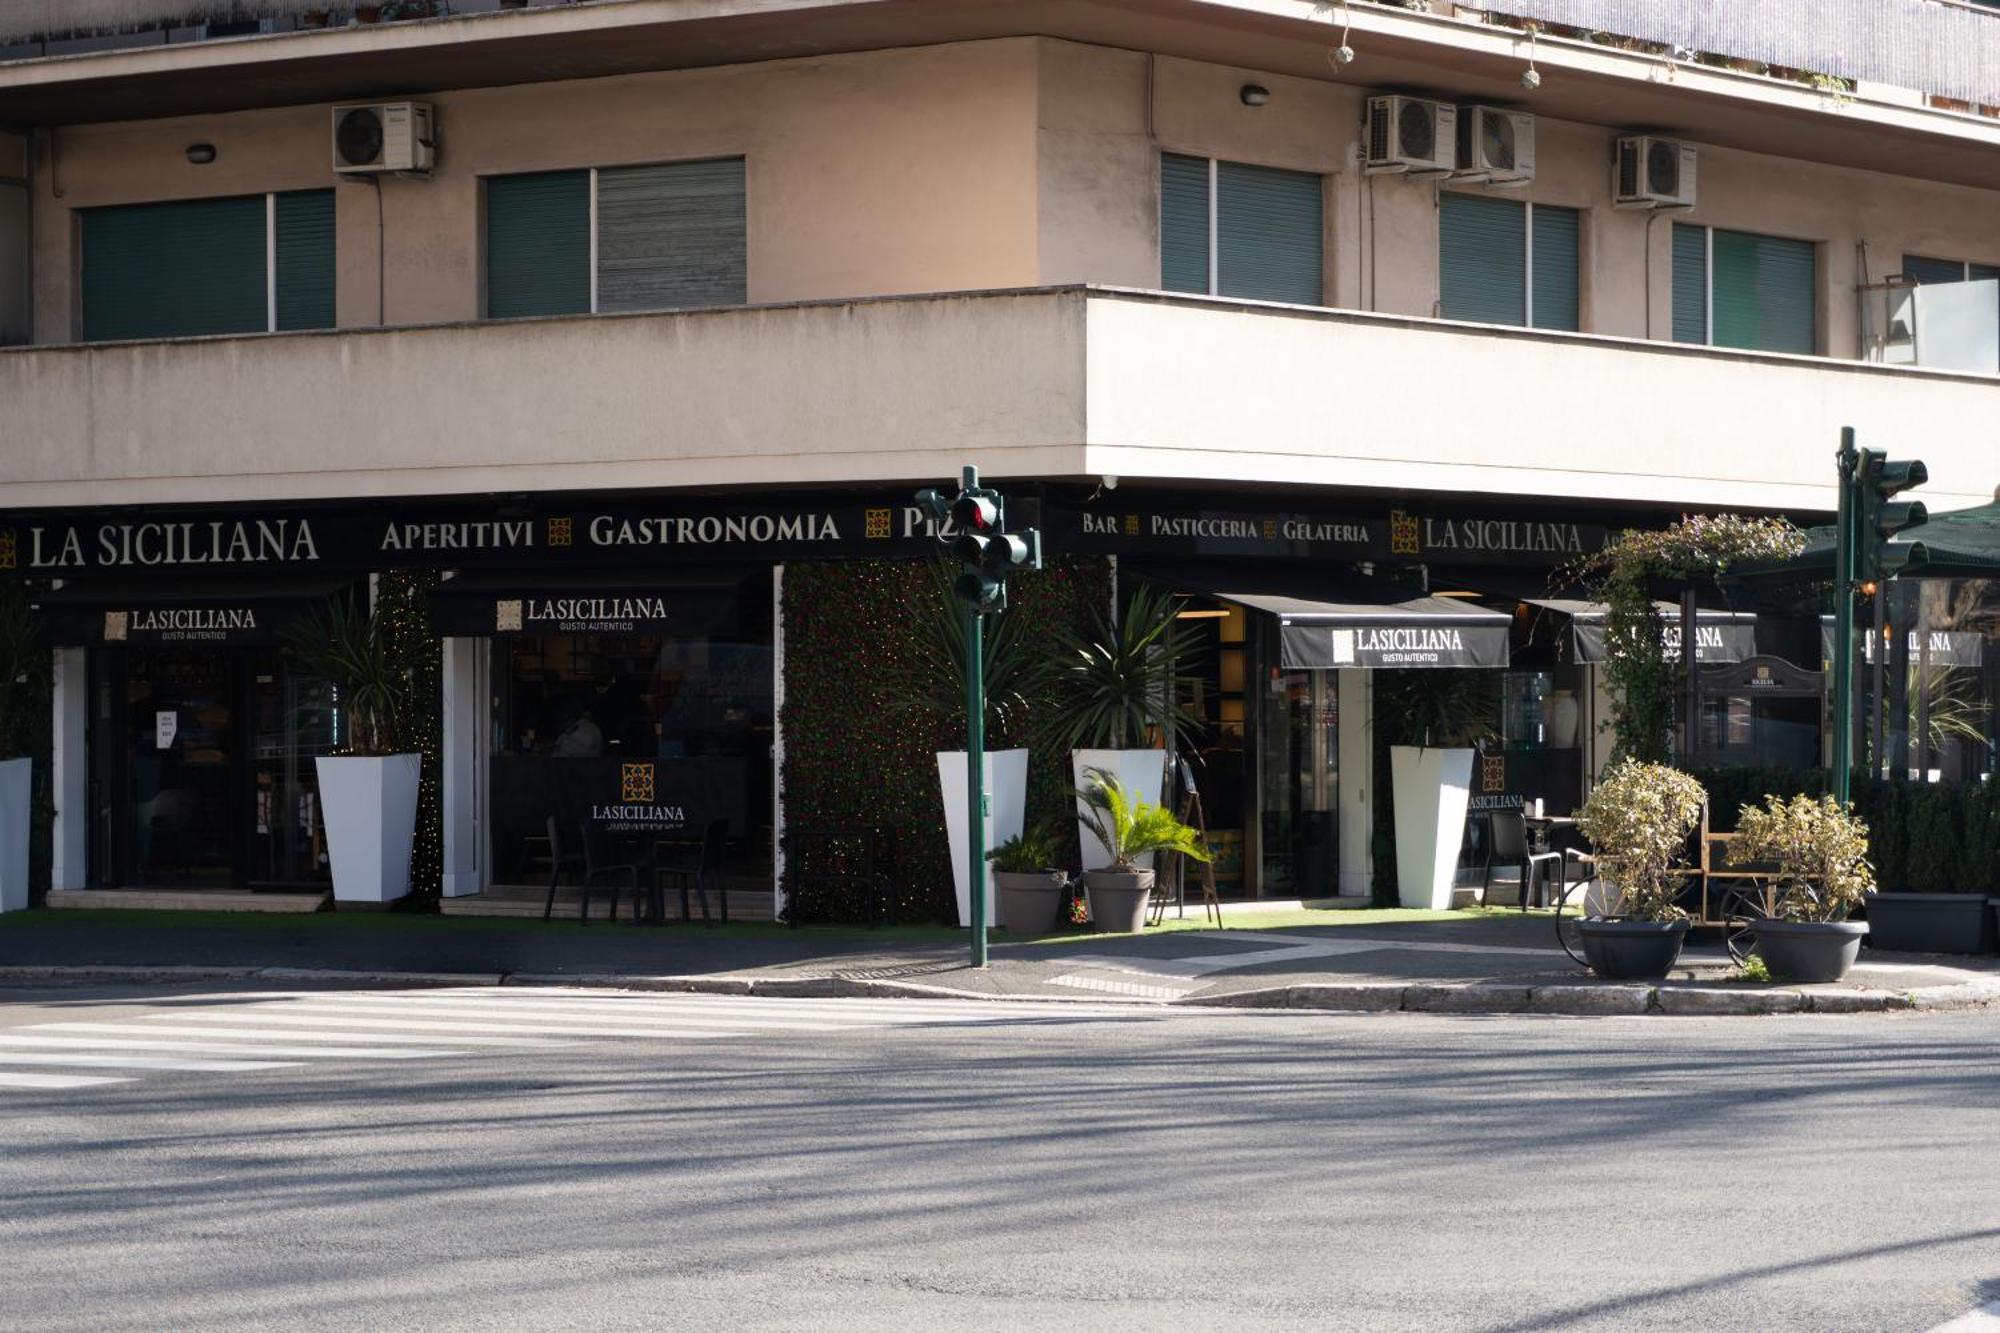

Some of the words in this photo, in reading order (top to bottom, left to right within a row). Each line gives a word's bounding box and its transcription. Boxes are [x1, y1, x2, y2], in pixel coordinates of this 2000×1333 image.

[589, 514, 841, 545] GASTRONOMIA
[1082, 512, 1118, 534] BAR
[1151, 515, 1258, 538] PASTICCERIA
[1282, 521, 1370, 544] GELATERIA
[29, 526, 86, 568] LA
[98, 519, 320, 566] SICILIANA
[381, 521, 533, 550] APERITIVI
[1425, 518, 1459, 549] LA
[1463, 520, 1583, 554] SICILIANA
[132, 609, 256, 631] LASICILIANA
[527, 598, 668, 620] LASICILIANA
[161, 631, 185, 641] GUSTO
[186, 631, 227, 641] AUTENTICO
[559, 621, 587, 631] GUSTO
[588, 621, 634, 632] AUTENTICO
[1356, 629, 1463, 651] LASICILIANA
[1382, 652, 1404, 662] GUSTO
[1404, 653, 1438, 663] AUTENTICO
[593, 805, 685, 820] LASICILIANA
[1470, 794, 1525, 809] ASICILIANA
